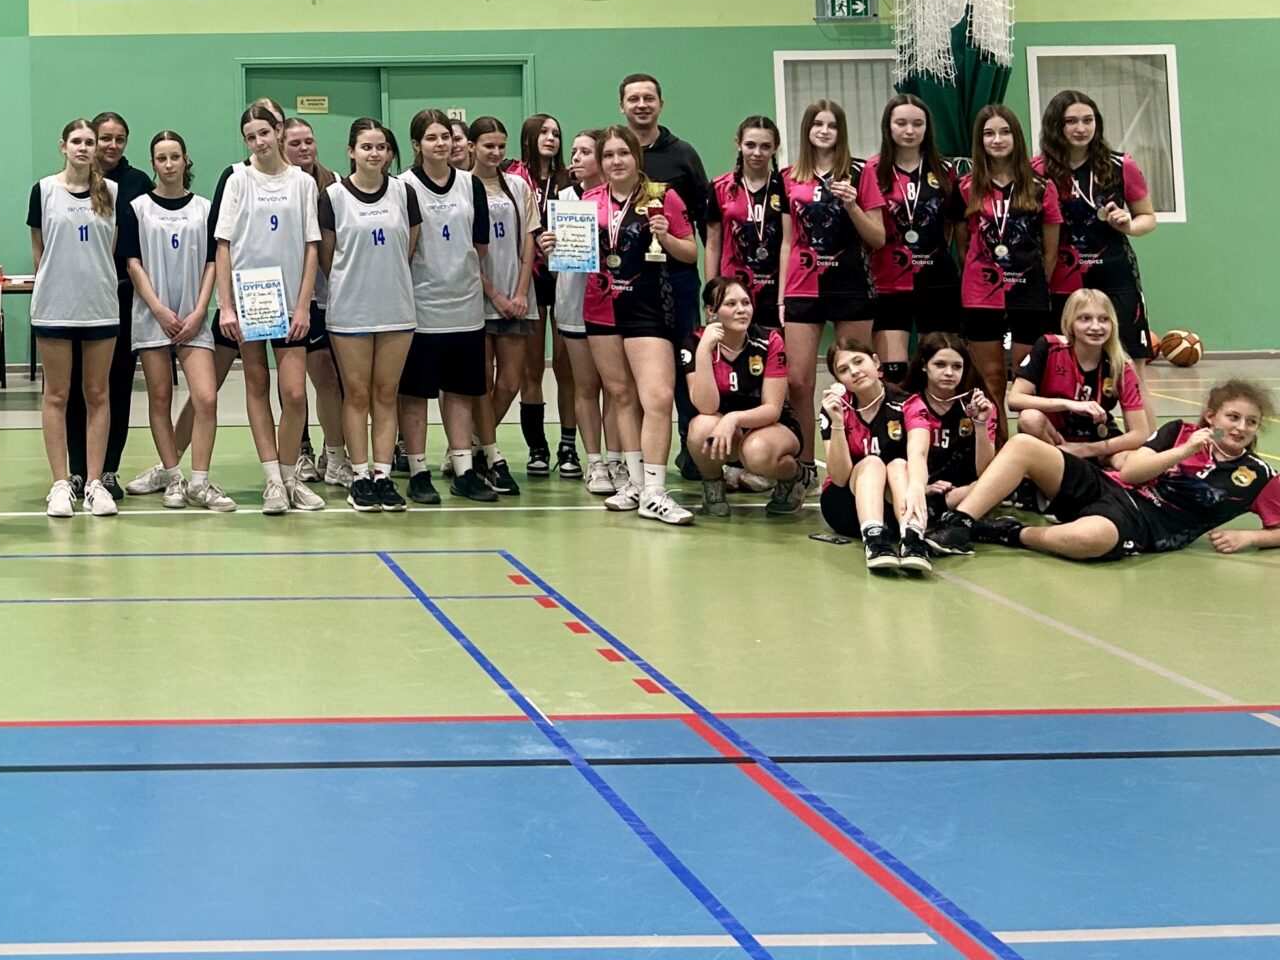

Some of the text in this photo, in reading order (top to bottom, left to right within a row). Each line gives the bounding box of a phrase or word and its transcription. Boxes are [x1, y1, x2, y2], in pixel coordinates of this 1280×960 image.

[813, 185, 822, 202] 5
[906, 182, 916, 200] 8
[359, 209, 389, 217] GIVOVA
[746, 204, 763, 222] 10
[270, 214, 278, 231] 9
[493, 222, 505, 238] 13
[78, 224, 89, 242] 11
[171, 233, 179, 249] 6
[371, 228, 386, 246] 14
[442, 224, 450, 241] 4
[243, 282, 281, 291] DYPLOM
[611, 284, 633, 292] Dobrcz
[1140, 330, 1148, 347] 4
[729, 371, 739, 392] 9
[862, 436, 881, 456] 14
[933, 428, 950, 448] 15
